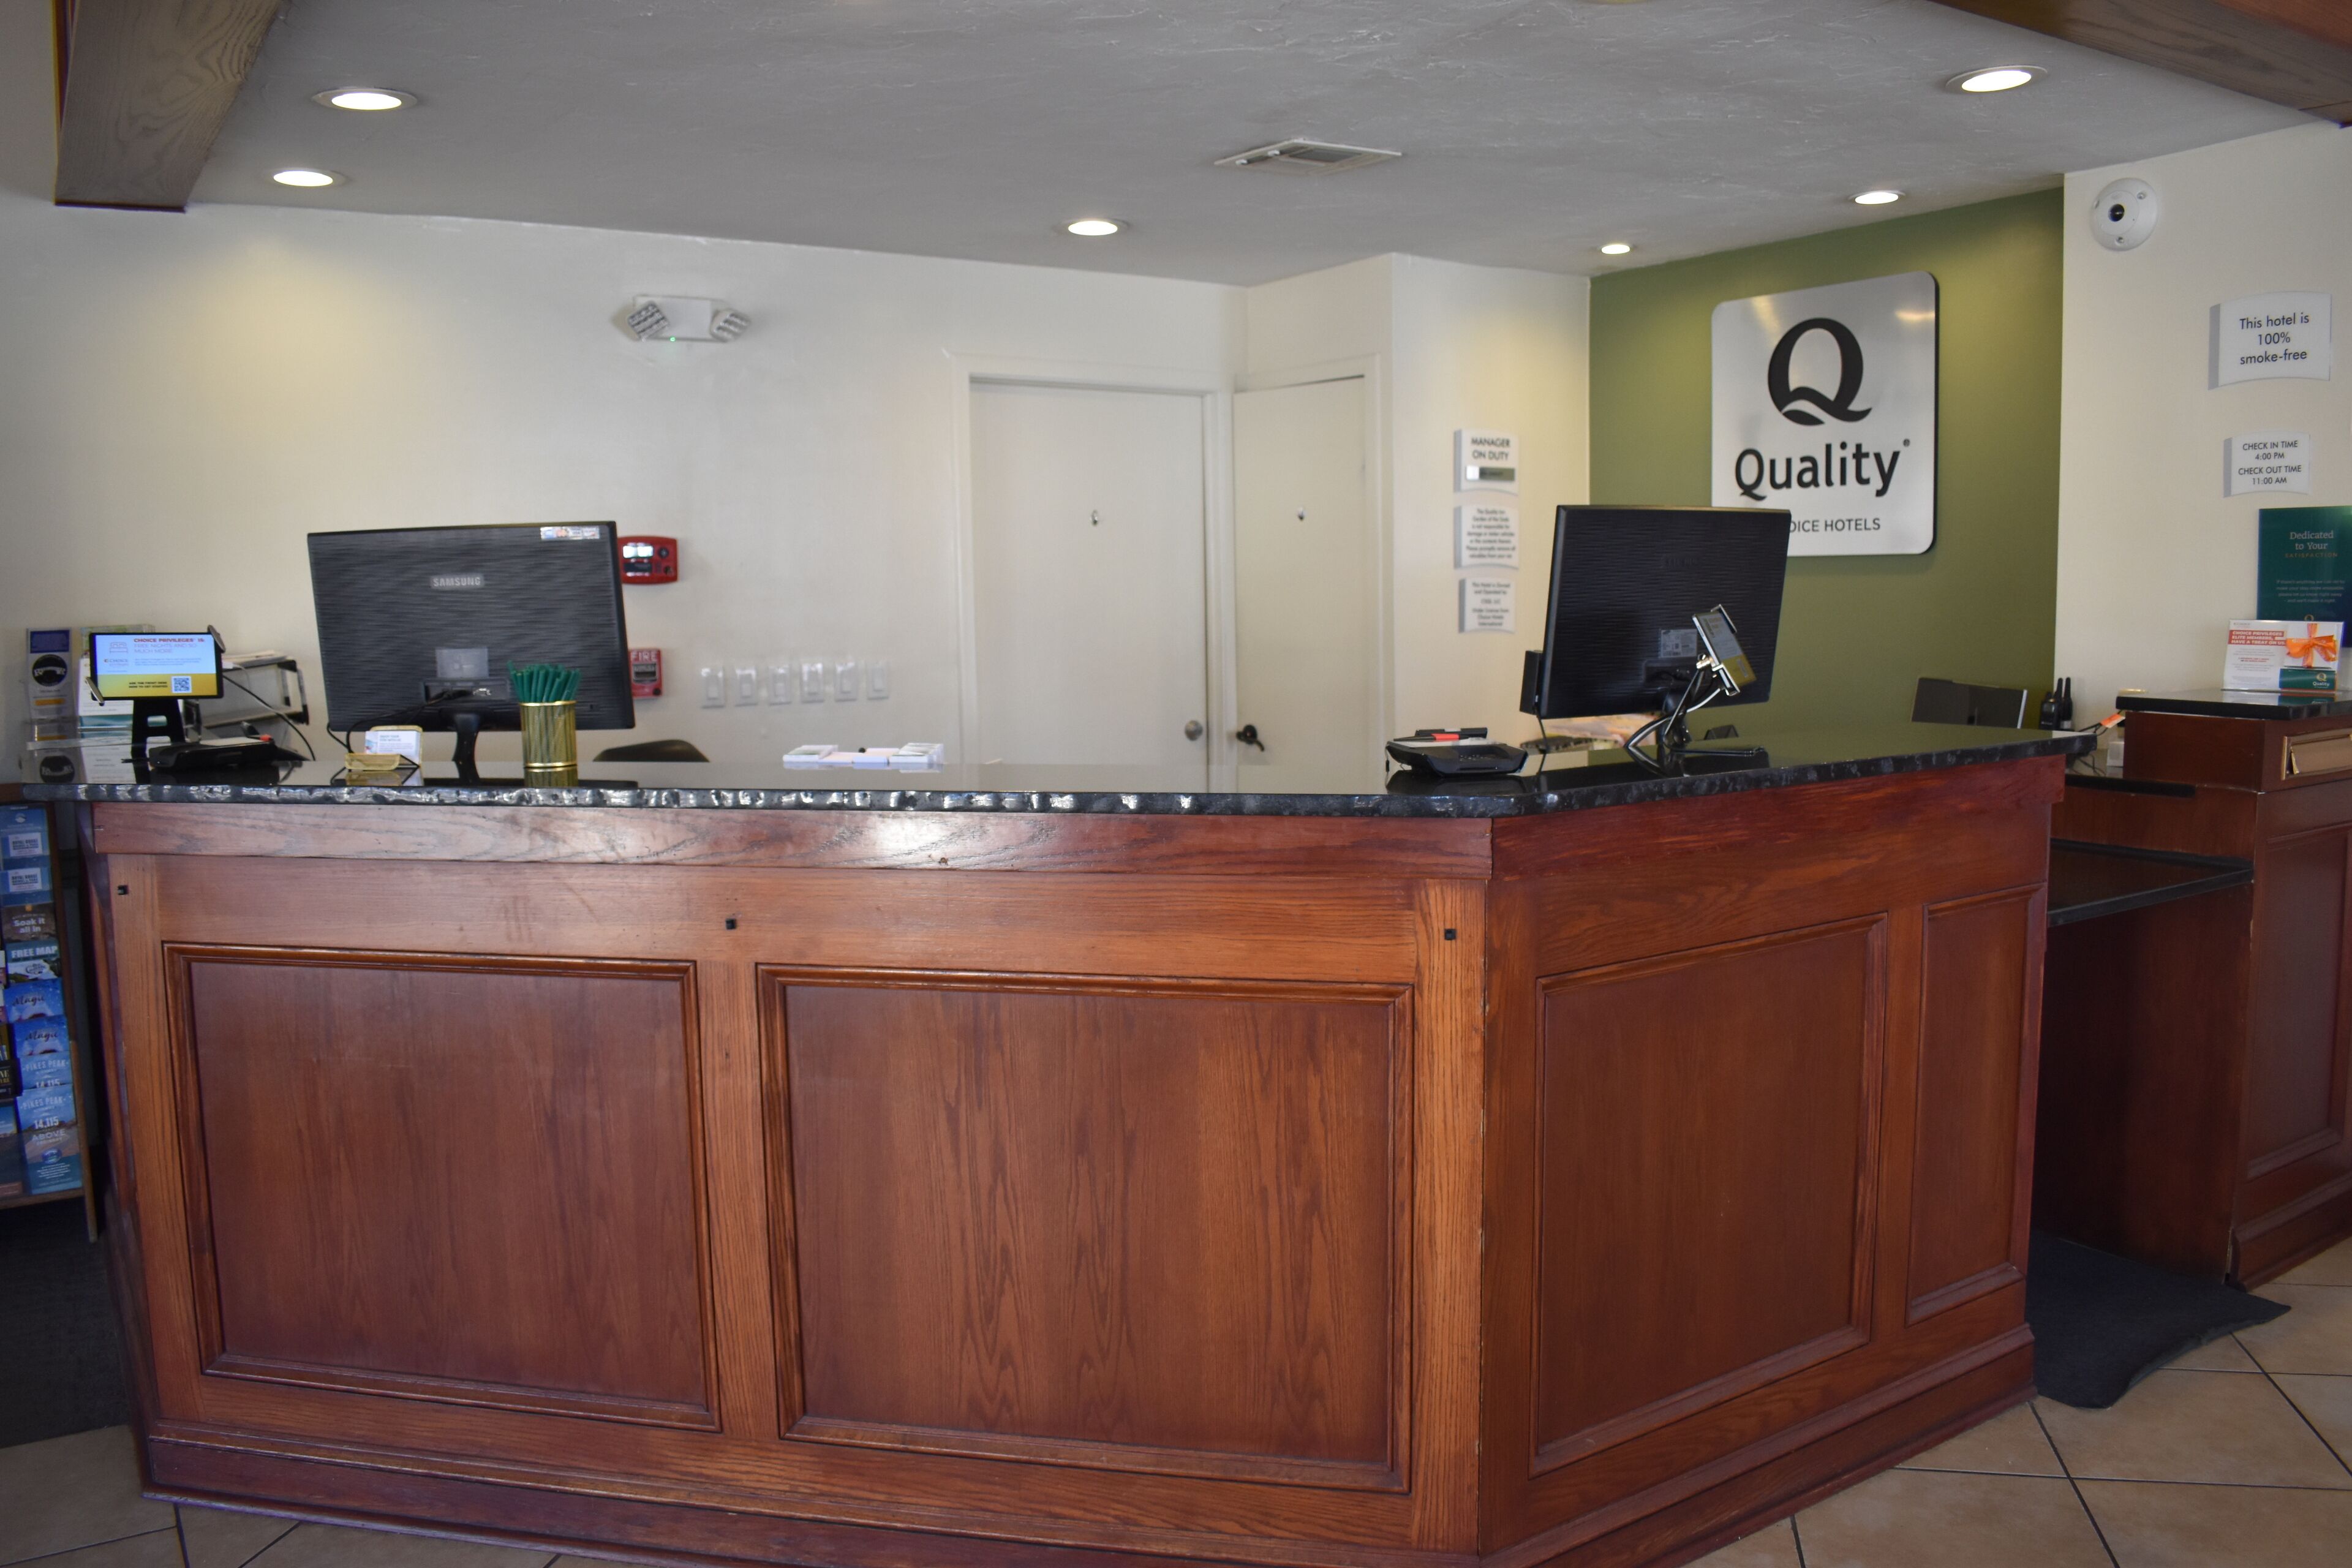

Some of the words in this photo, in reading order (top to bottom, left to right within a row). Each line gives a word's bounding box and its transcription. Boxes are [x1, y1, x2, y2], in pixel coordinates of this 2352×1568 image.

[2239, 317, 2262, 330] This
[2266, 312, 2296, 327] hotel
[2301, 312, 2309, 323] is
[2258, 331, 2291, 345] 100%
[2240, 349, 2307, 365] smoke-free
[1768, 317, 1872, 426] Q
[1471, 437, 1510, 448] MANAGER
[2242, 442, 2267, 451] CHECK
[1472, 450, 1486, 459] ON
[1488, 450, 1509, 461] DUTY
[1735, 441, 1901, 501] Quality
[2238, 467, 2263, 475] CHECK
[1790, 519, 1820, 533] OICE
[1824, 518, 1880, 532] HOTELS
[2290, 530, 2334, 540] Dedicated
[433, 577, 481, 587] SAMSUNG
[631, 651, 658, 662] FIRE
[12, 948, 34, 958] FREE
[36, 946, 58, 956] MAP
[26, 1061, 46, 1071] PIKES
[48, 1060, 66, 1068] PEAK
[23, 1098, 43, 1109] PIKES
[46, 1096, 63, 1105] PEAK
[32, 1129, 66, 1140] ABOVE
